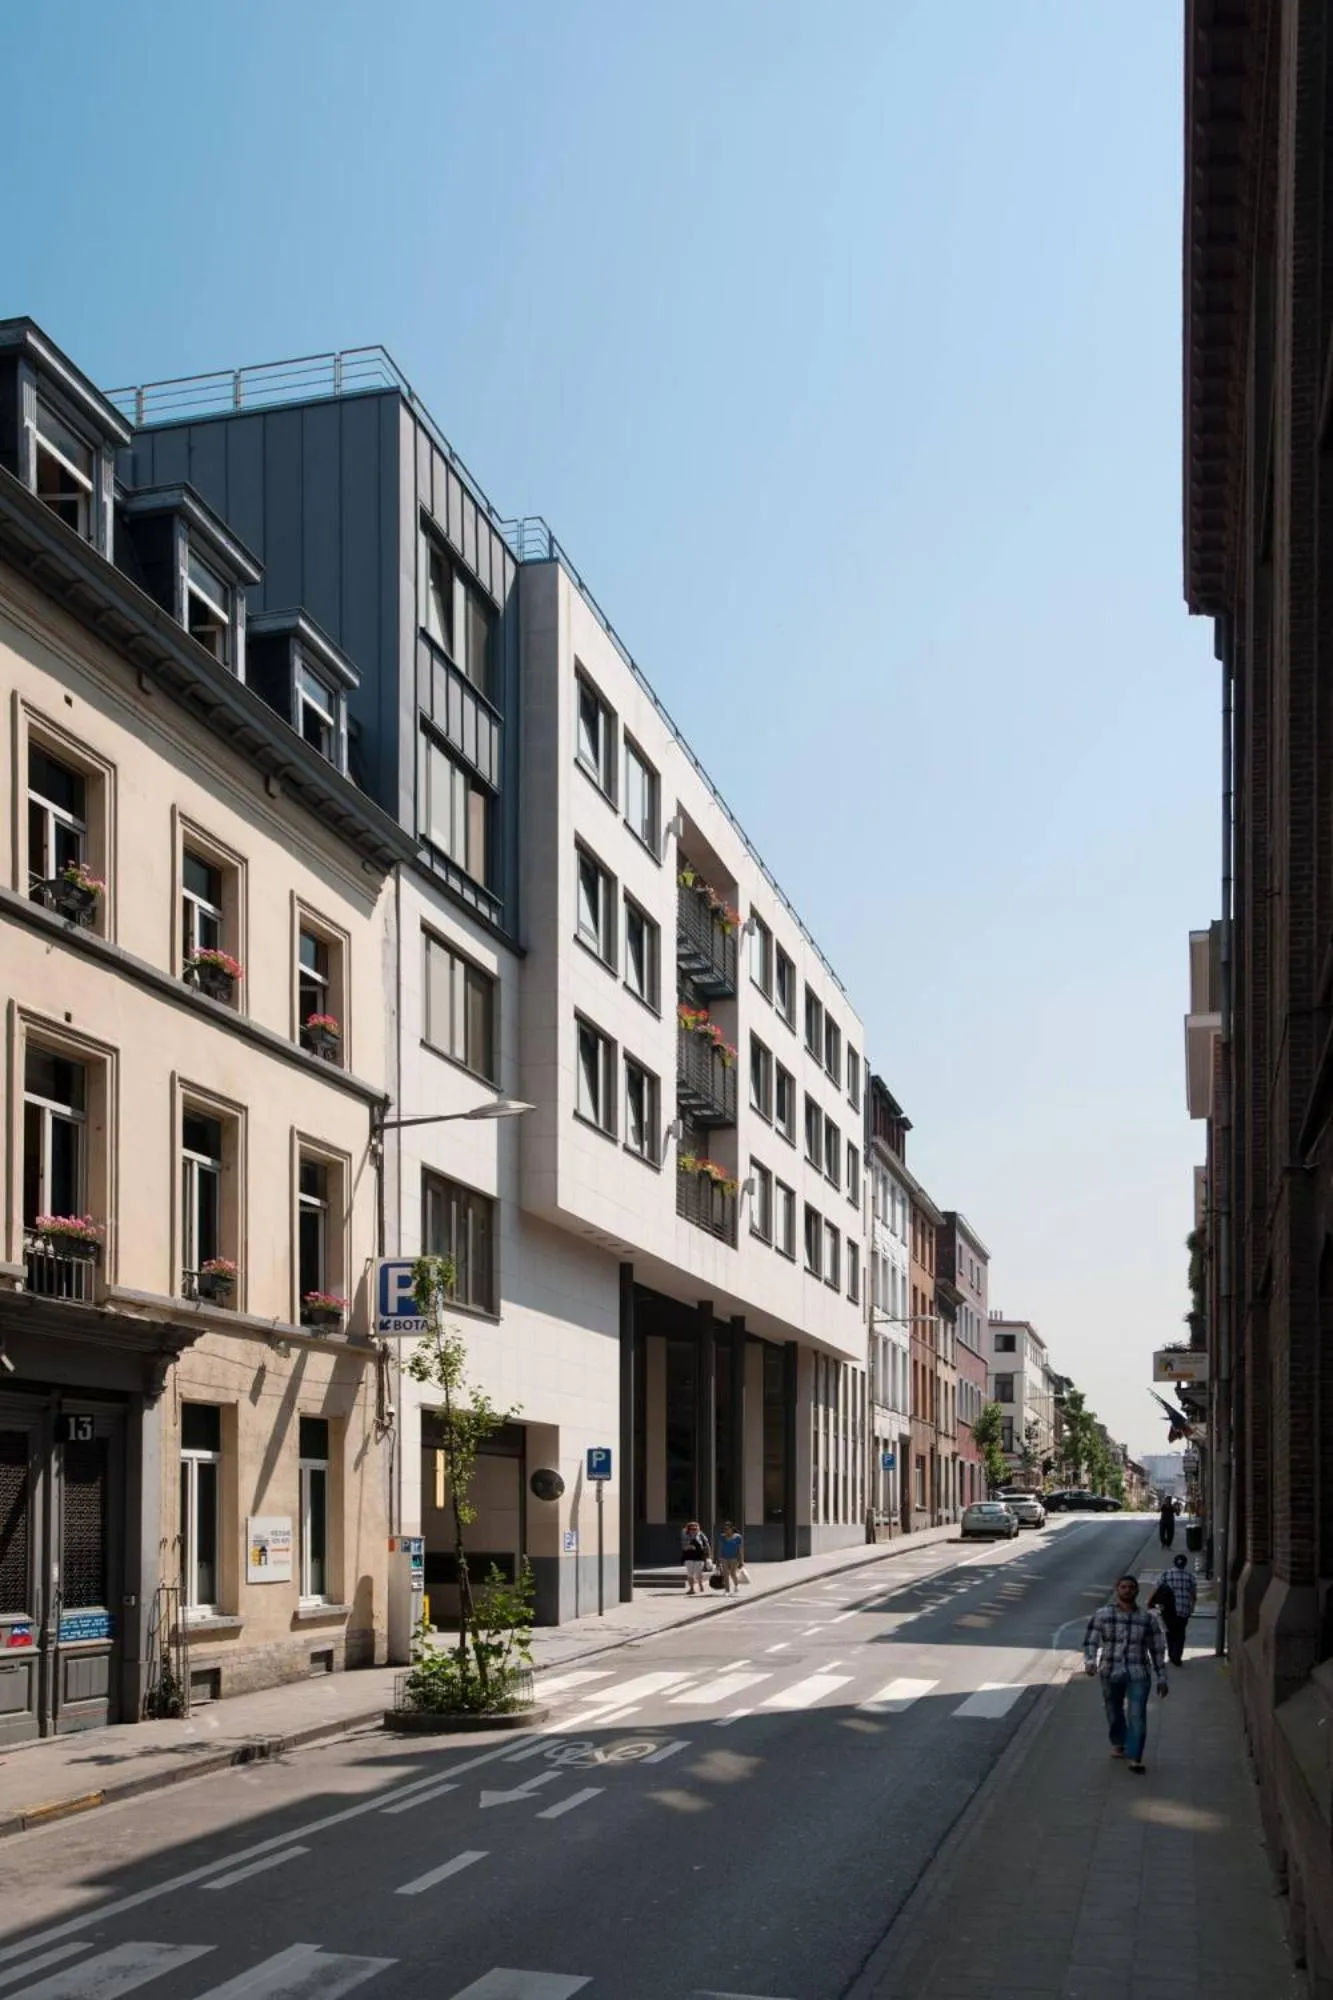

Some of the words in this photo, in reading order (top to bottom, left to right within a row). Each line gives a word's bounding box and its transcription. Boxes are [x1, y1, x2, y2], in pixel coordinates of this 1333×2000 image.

[388, 1267, 418, 1313] P
[393, 1319, 429, 1331] BOTA
[68, 1416, 92, 1441] 13
[592, 1450, 606, 1470] P
[884, 1455, 893, 1465] P
